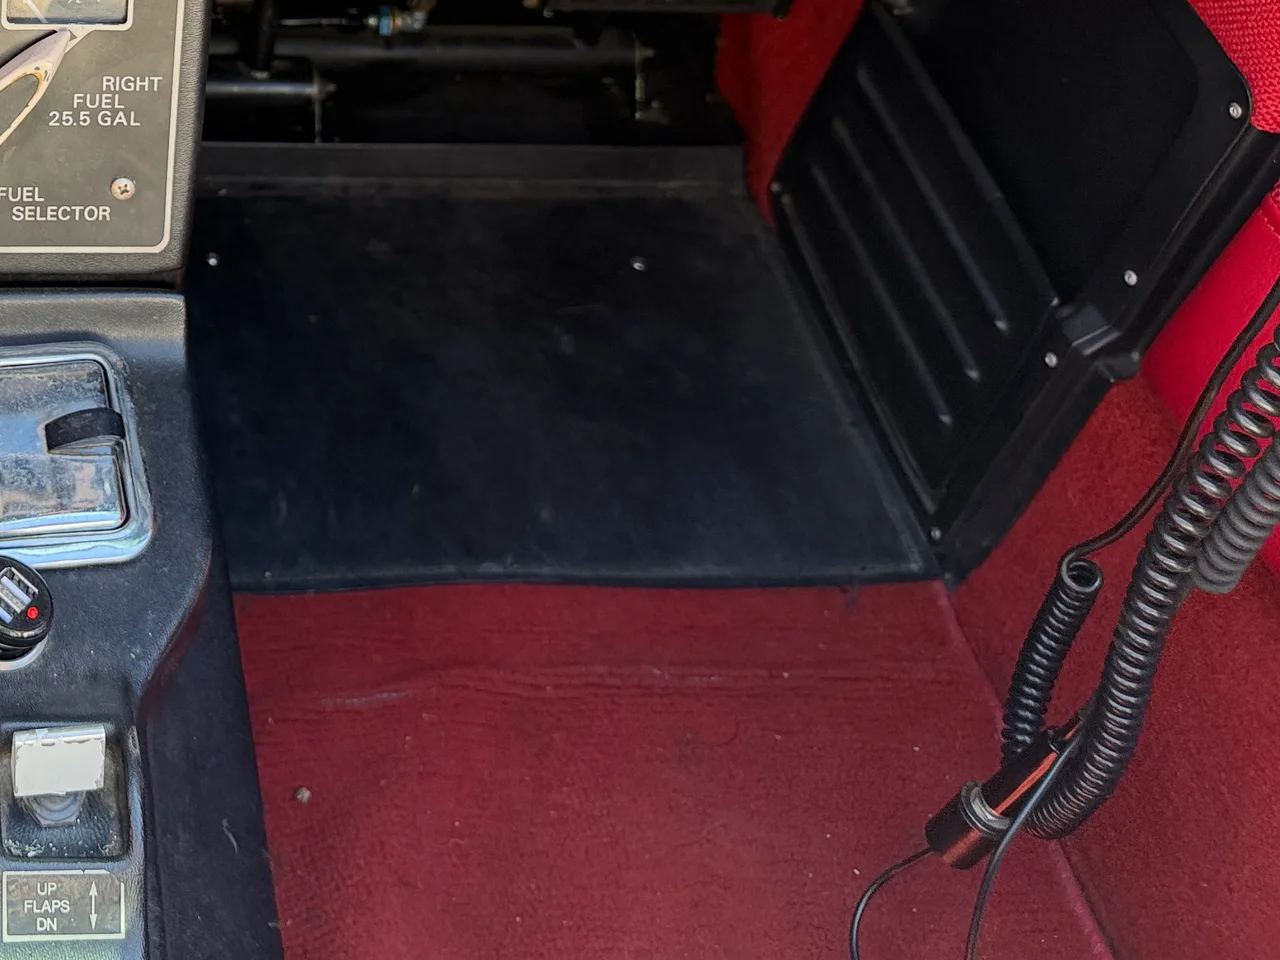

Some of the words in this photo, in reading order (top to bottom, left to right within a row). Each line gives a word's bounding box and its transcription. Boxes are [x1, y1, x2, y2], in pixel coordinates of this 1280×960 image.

[101, 76, 162, 92] RIGHT
[72, 93, 124, 110] FUEL
[47, 111, 91, 127] 25.5
[96, 111, 141, 127] GAL
[11, 205, 111, 222] SELECTOR
[37, 882, 58, 896] UP
[24, 899, 70, 914] FLAPS
[36, 917, 58, 932] DN
